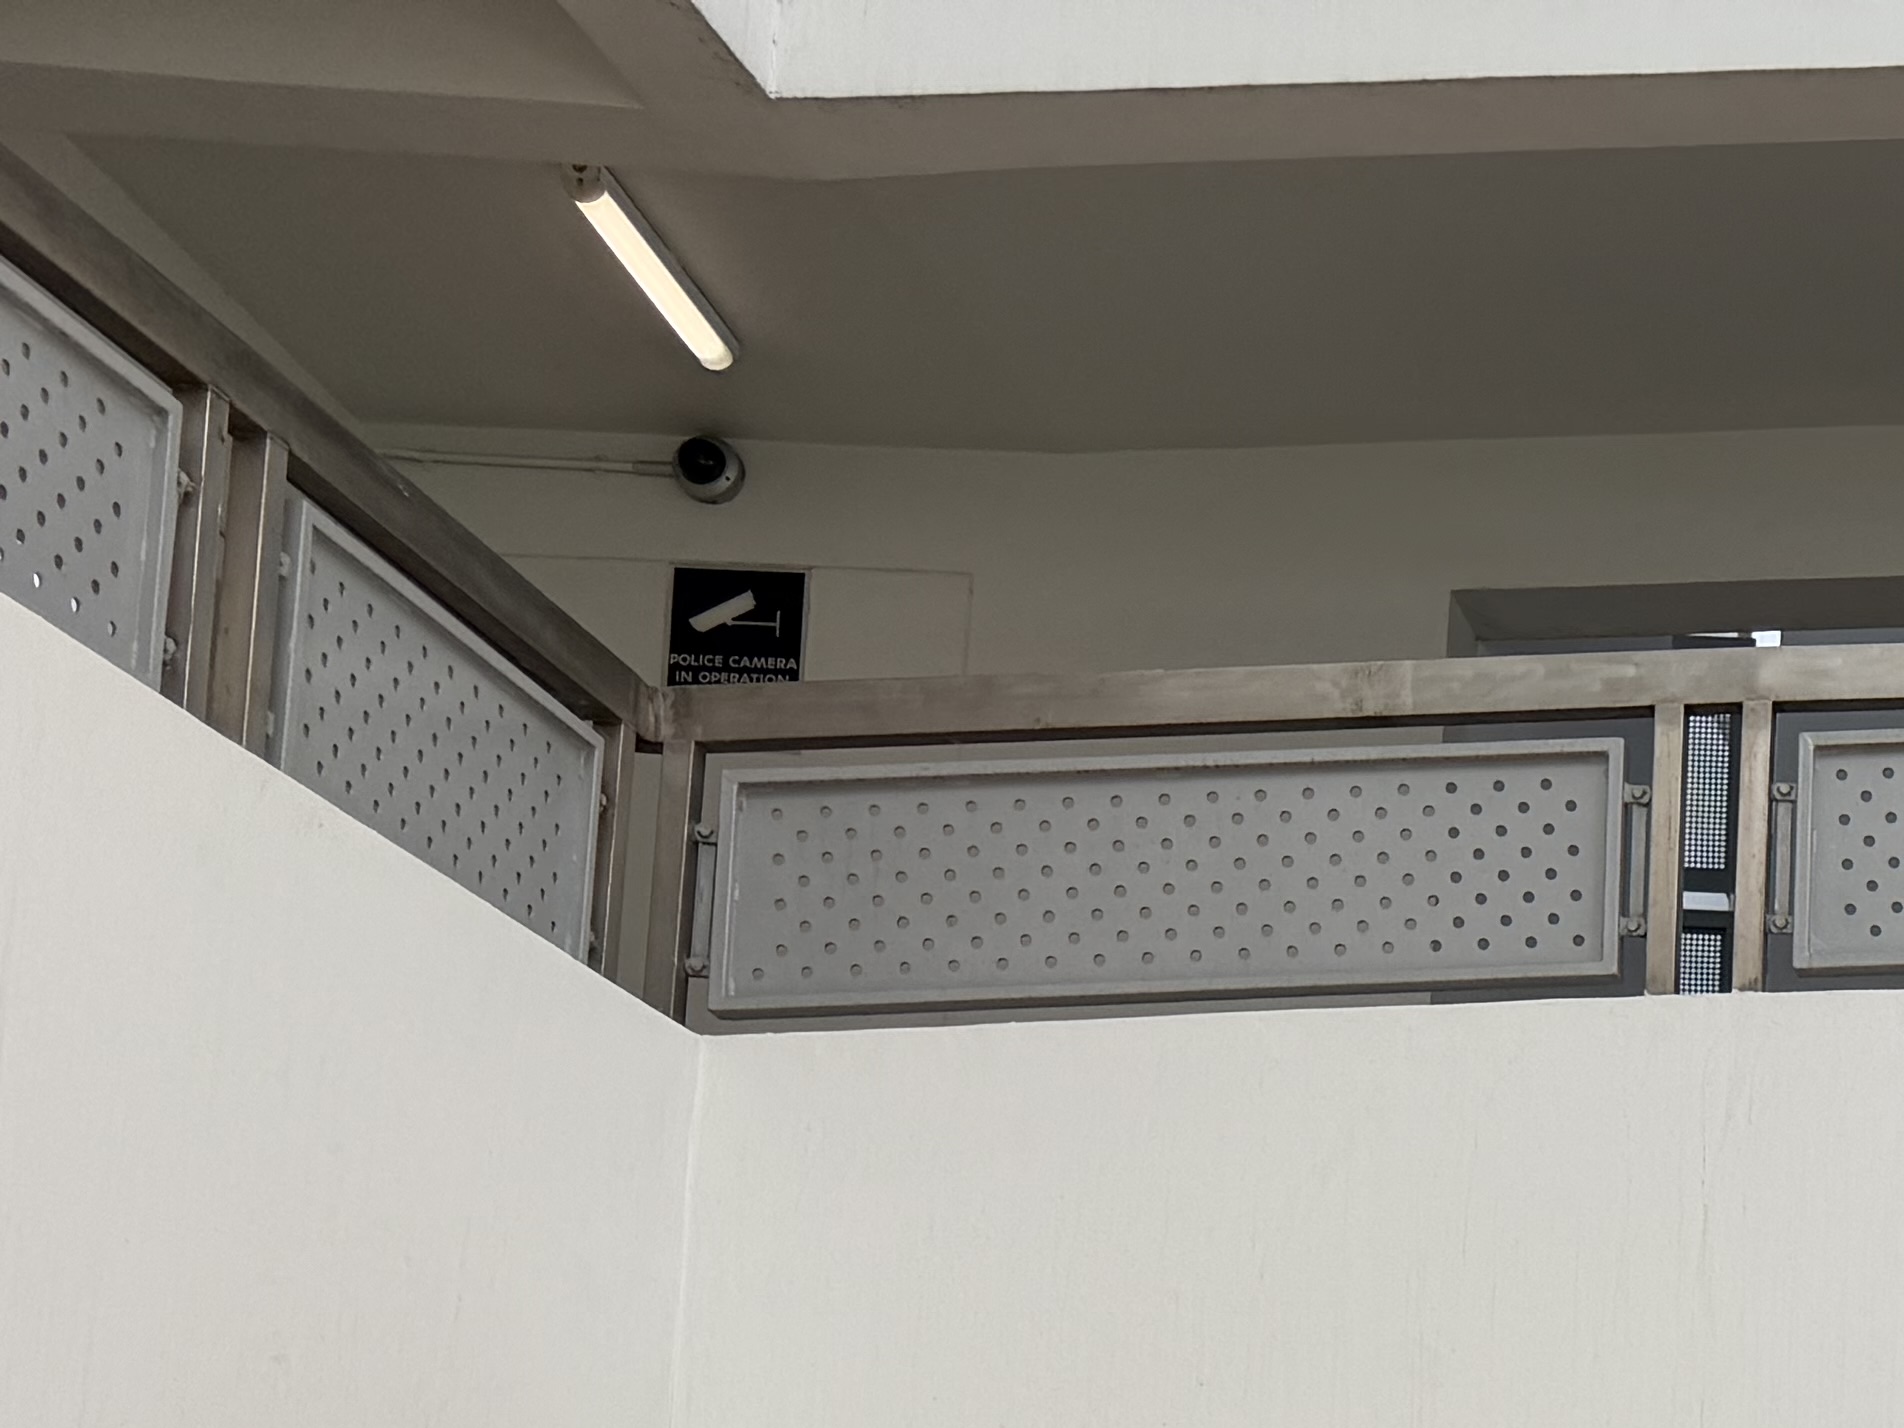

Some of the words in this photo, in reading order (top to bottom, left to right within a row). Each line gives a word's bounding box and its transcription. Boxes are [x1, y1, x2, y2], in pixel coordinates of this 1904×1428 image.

[670, 653, 723, 667] POLICE
[729, 656, 798, 670] CAMERA
[676, 670, 692, 682] IN
